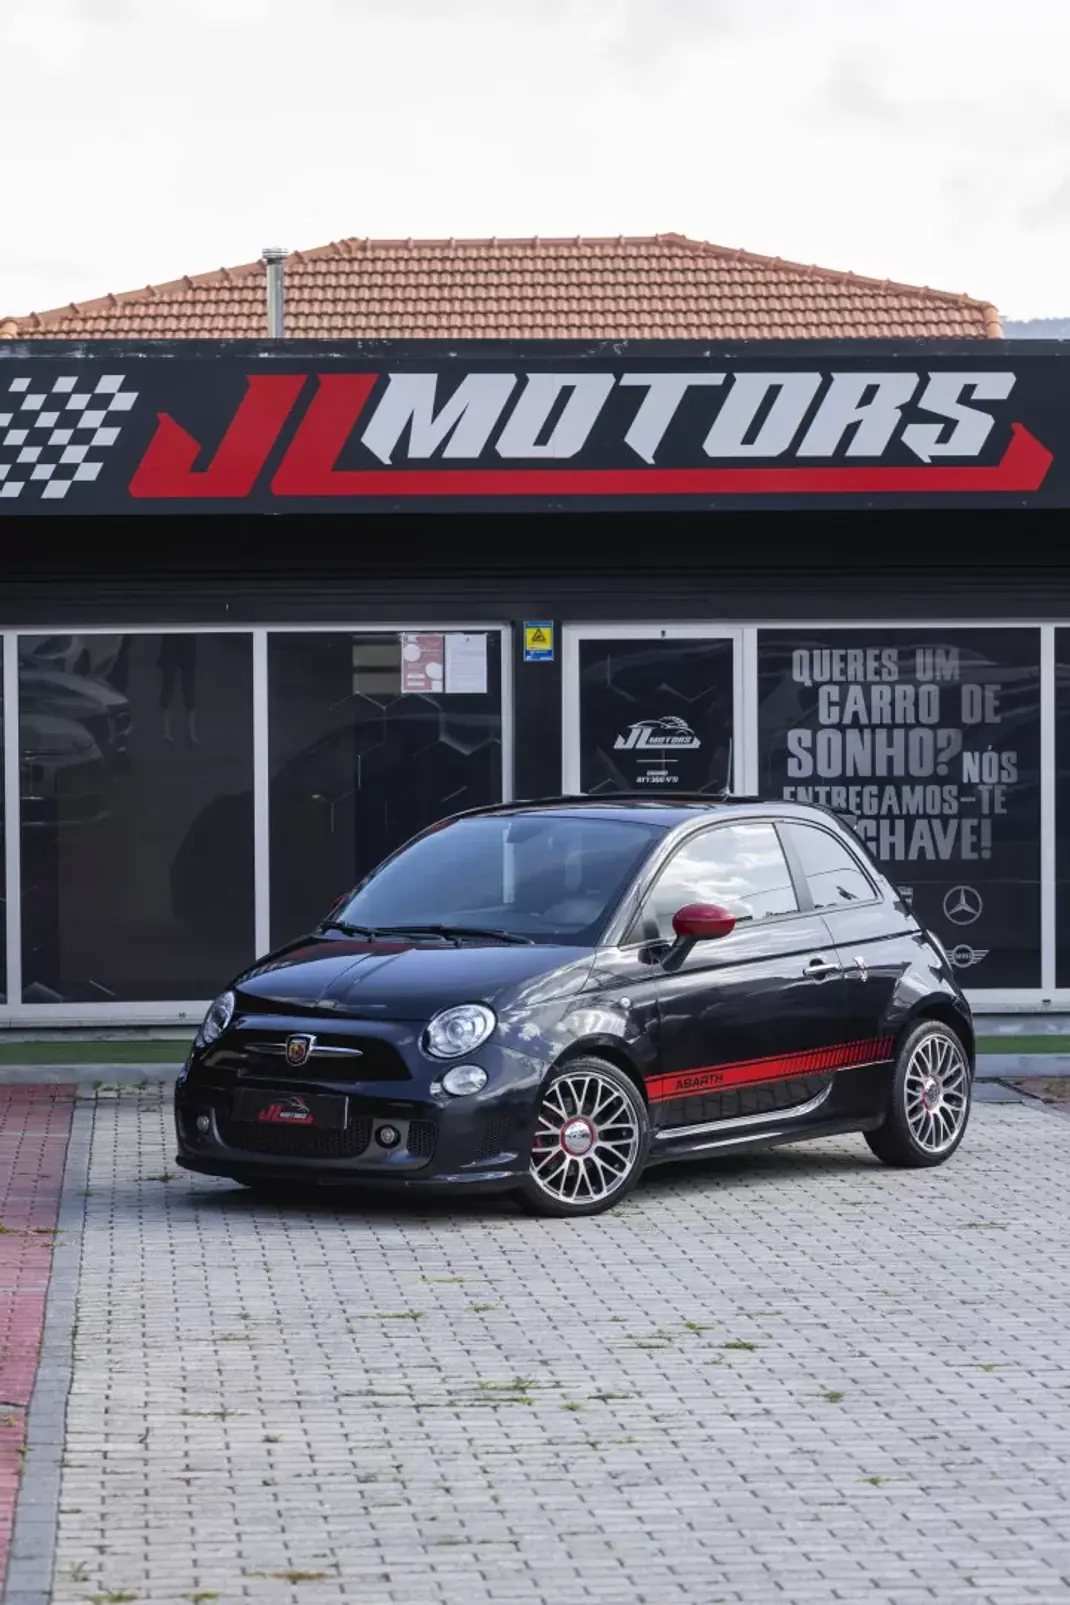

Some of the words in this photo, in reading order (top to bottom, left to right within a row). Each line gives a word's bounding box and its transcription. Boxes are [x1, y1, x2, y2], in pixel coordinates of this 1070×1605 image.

[360, 371, 1017, 465] MOTORS
[792, 649, 898, 687] QUERES
[915, 649, 960, 681] UM
[818, 684, 940, 724] CARRO
[961, 684, 1001, 723] DE
[787, 728, 963, 778] SONHO?
[962, 745, 1018, 783] NÓS
[858, 819, 992, 861] CHAVE!
[675, 1073, 724, 1089] ABARTH
